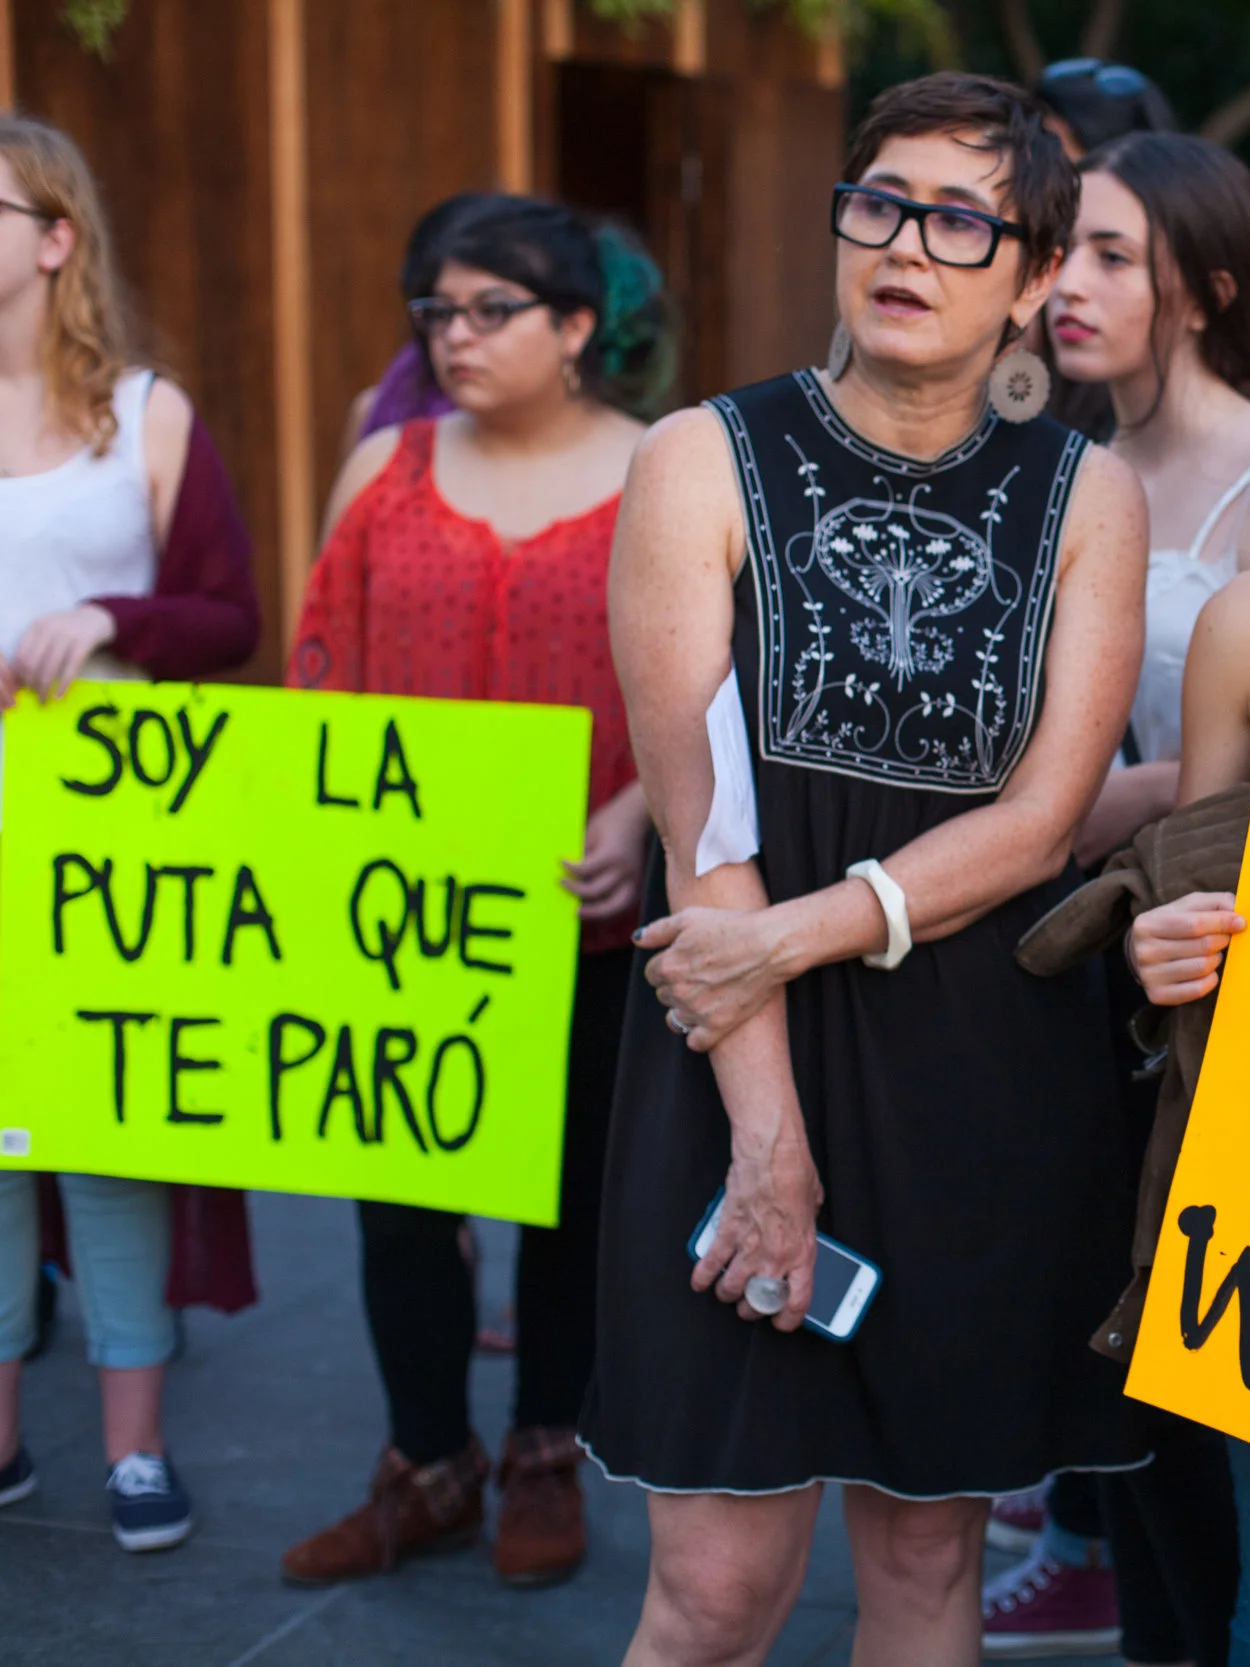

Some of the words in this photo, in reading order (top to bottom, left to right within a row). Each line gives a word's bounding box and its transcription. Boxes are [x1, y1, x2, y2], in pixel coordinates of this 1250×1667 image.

[61, 704, 229, 814] SOY
[314, 718, 422, 819] LA
[52, 851, 282, 966] PUTA
[350, 858, 525, 991] QUE
[76, 1008, 226, 1125] TE
[268, 993, 490, 1155] PARÓ
